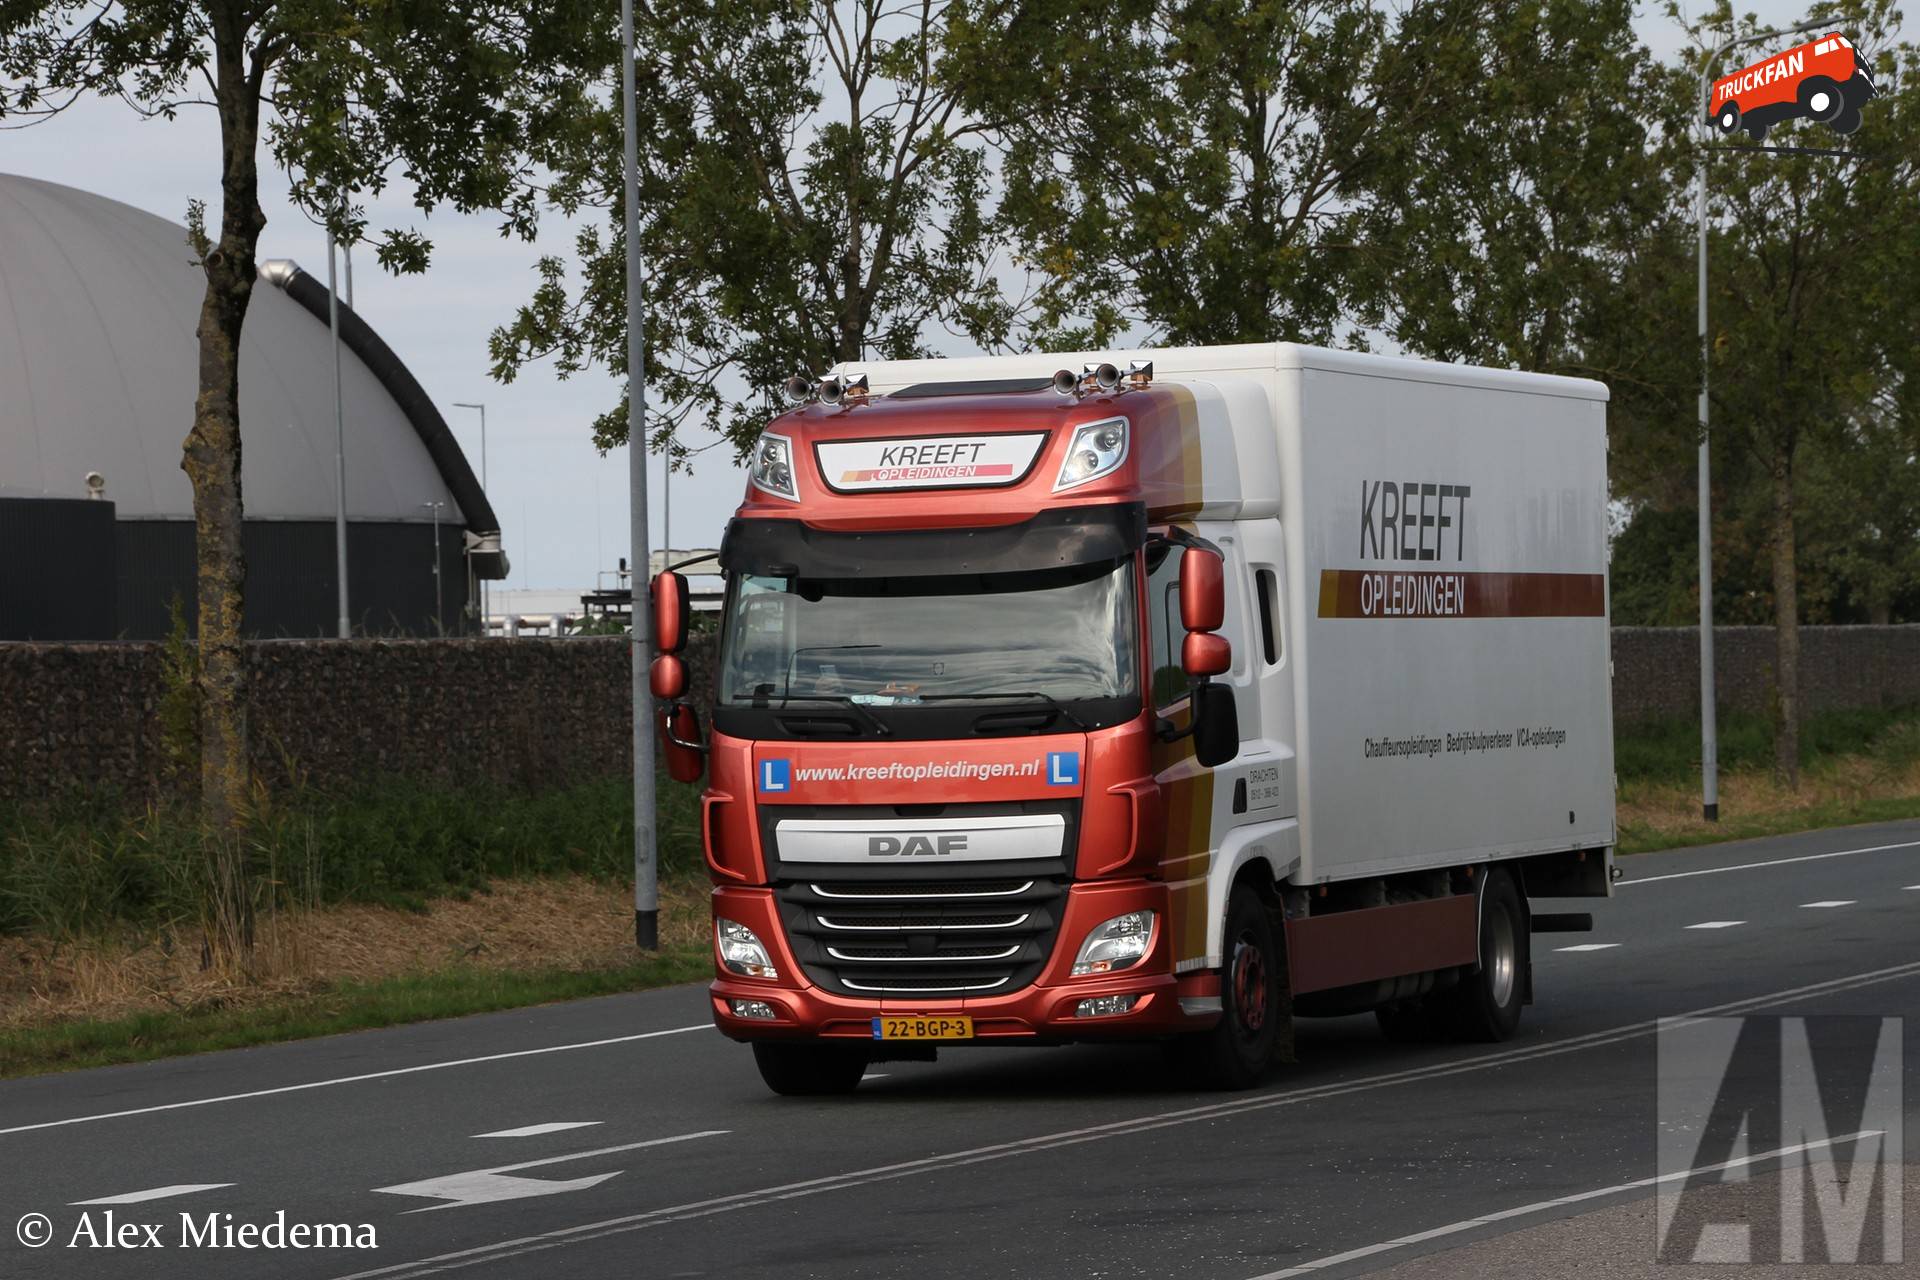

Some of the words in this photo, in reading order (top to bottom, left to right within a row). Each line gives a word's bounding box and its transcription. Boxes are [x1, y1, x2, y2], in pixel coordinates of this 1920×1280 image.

[879, 443, 986, 466] KREEFT
[878, 465, 976, 479] OPLEIDINGEN
[1360, 480, 1471, 562] KREEFT
[1361, 574, 1465, 615] OPLEIDINGEN
[1364, 735, 1442, 759] Chauffeursopleidingen
[765, 762, 784, 790] L
[795, 759, 1039, 782] www.kreeftopleidingen.nl
[1053, 755, 1073, 783] L
[868, 835, 968, 856] DAF
[888, 1020, 966, 1036] 22-BGP-3
